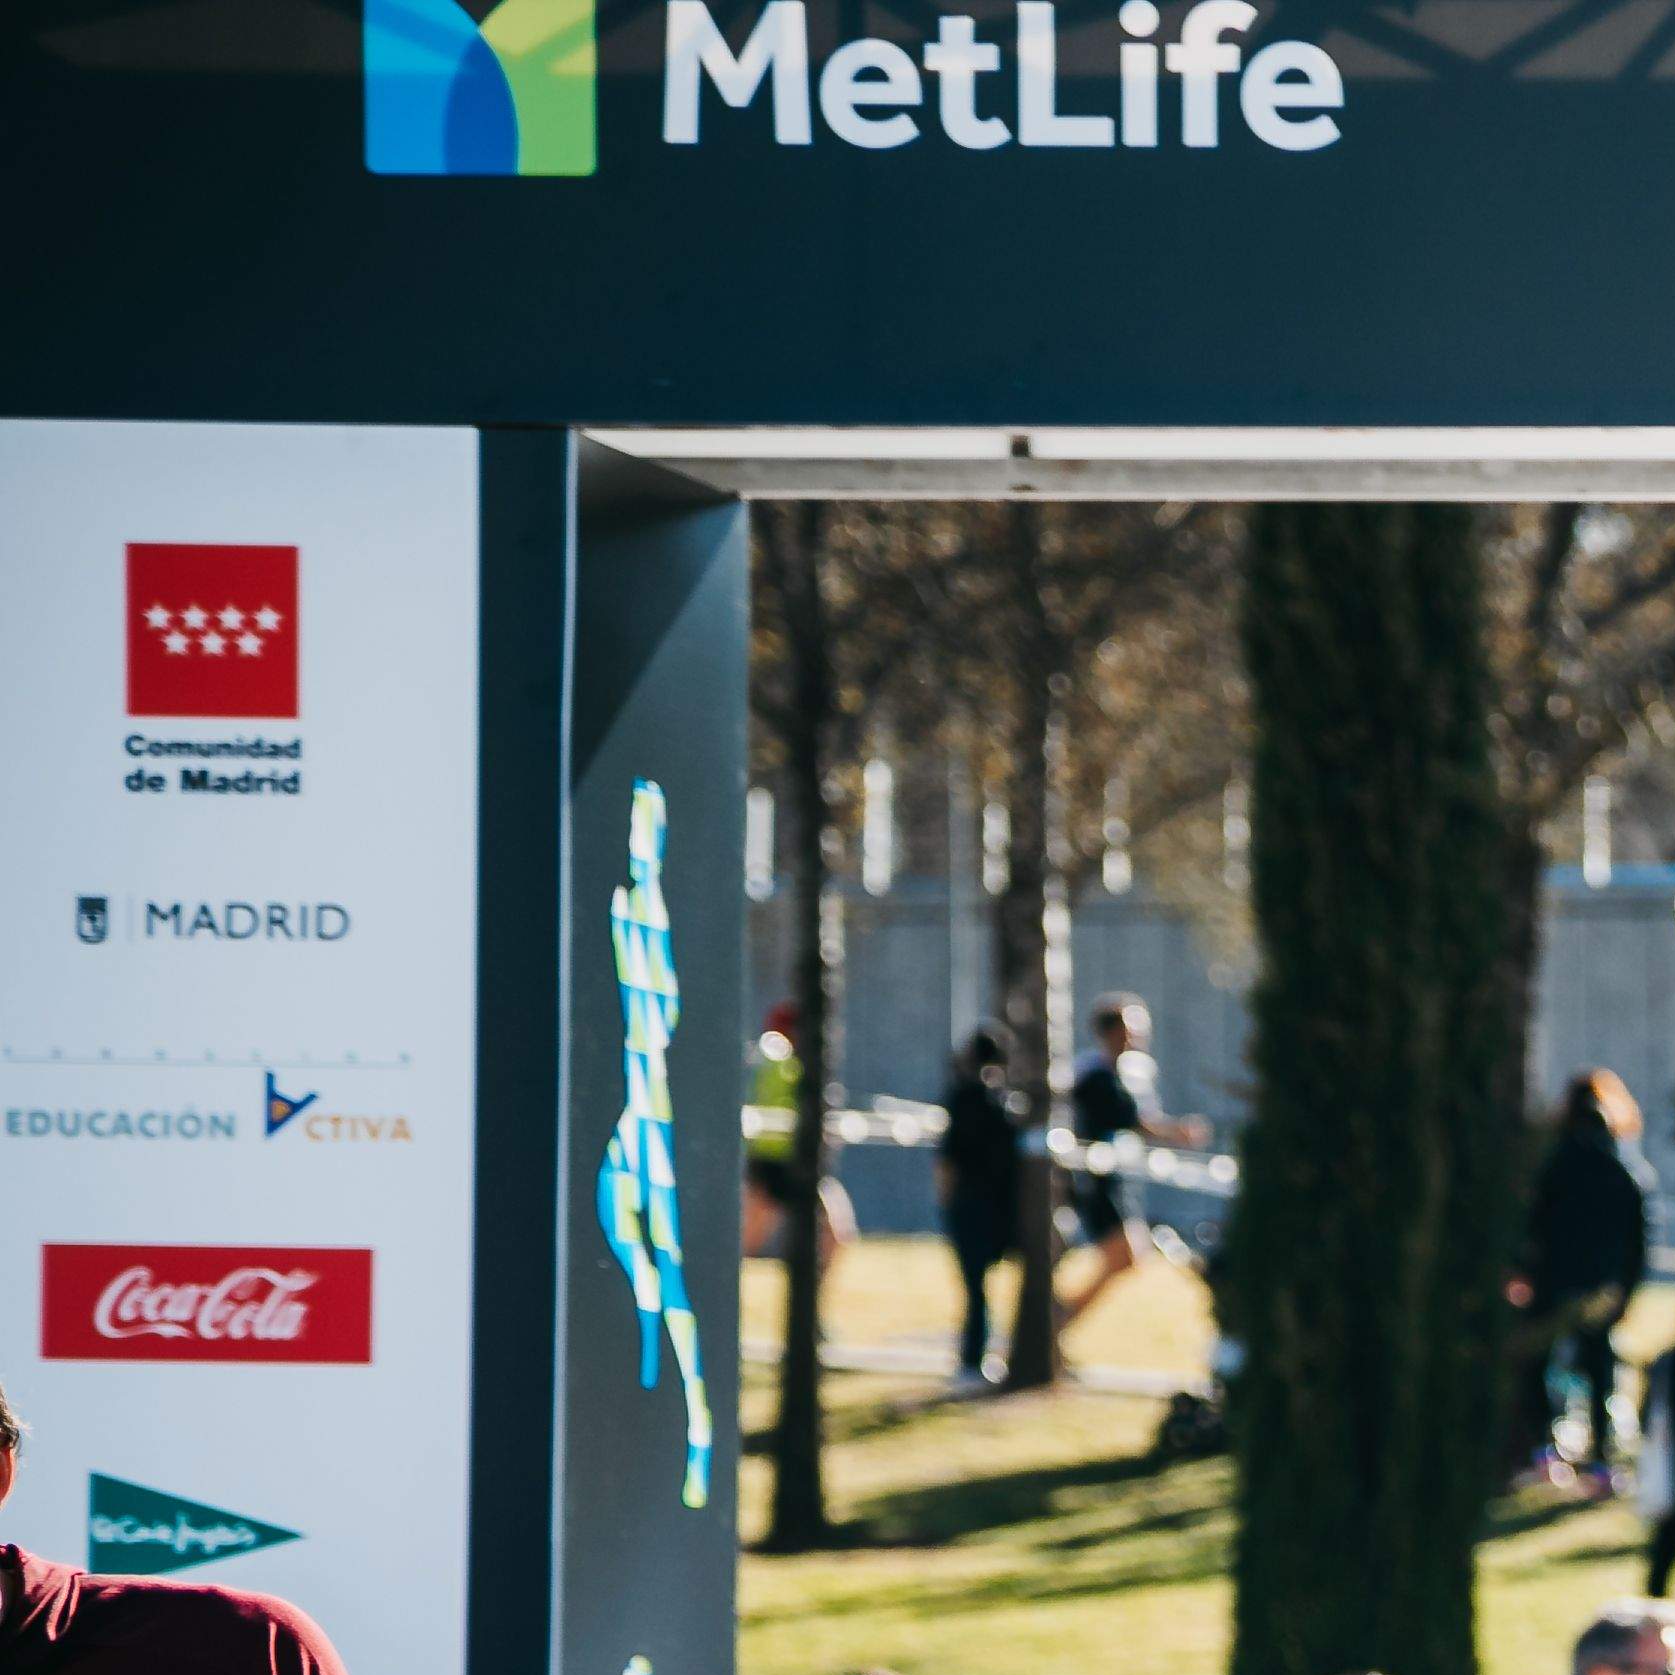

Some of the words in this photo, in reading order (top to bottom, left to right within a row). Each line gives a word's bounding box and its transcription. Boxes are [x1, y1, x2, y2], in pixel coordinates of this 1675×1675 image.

[662, 0, 1345, 151] MetLife
[125, 734, 303, 758] Comunidad
[125, 768, 166, 793] de
[181, 769, 301, 794] Madrid
[146, 902, 352, 940] MADRID
[5, 1107, 236, 1139] EDUCACIÓN
[94, 1266, 319, 1339] Coca-Cola
